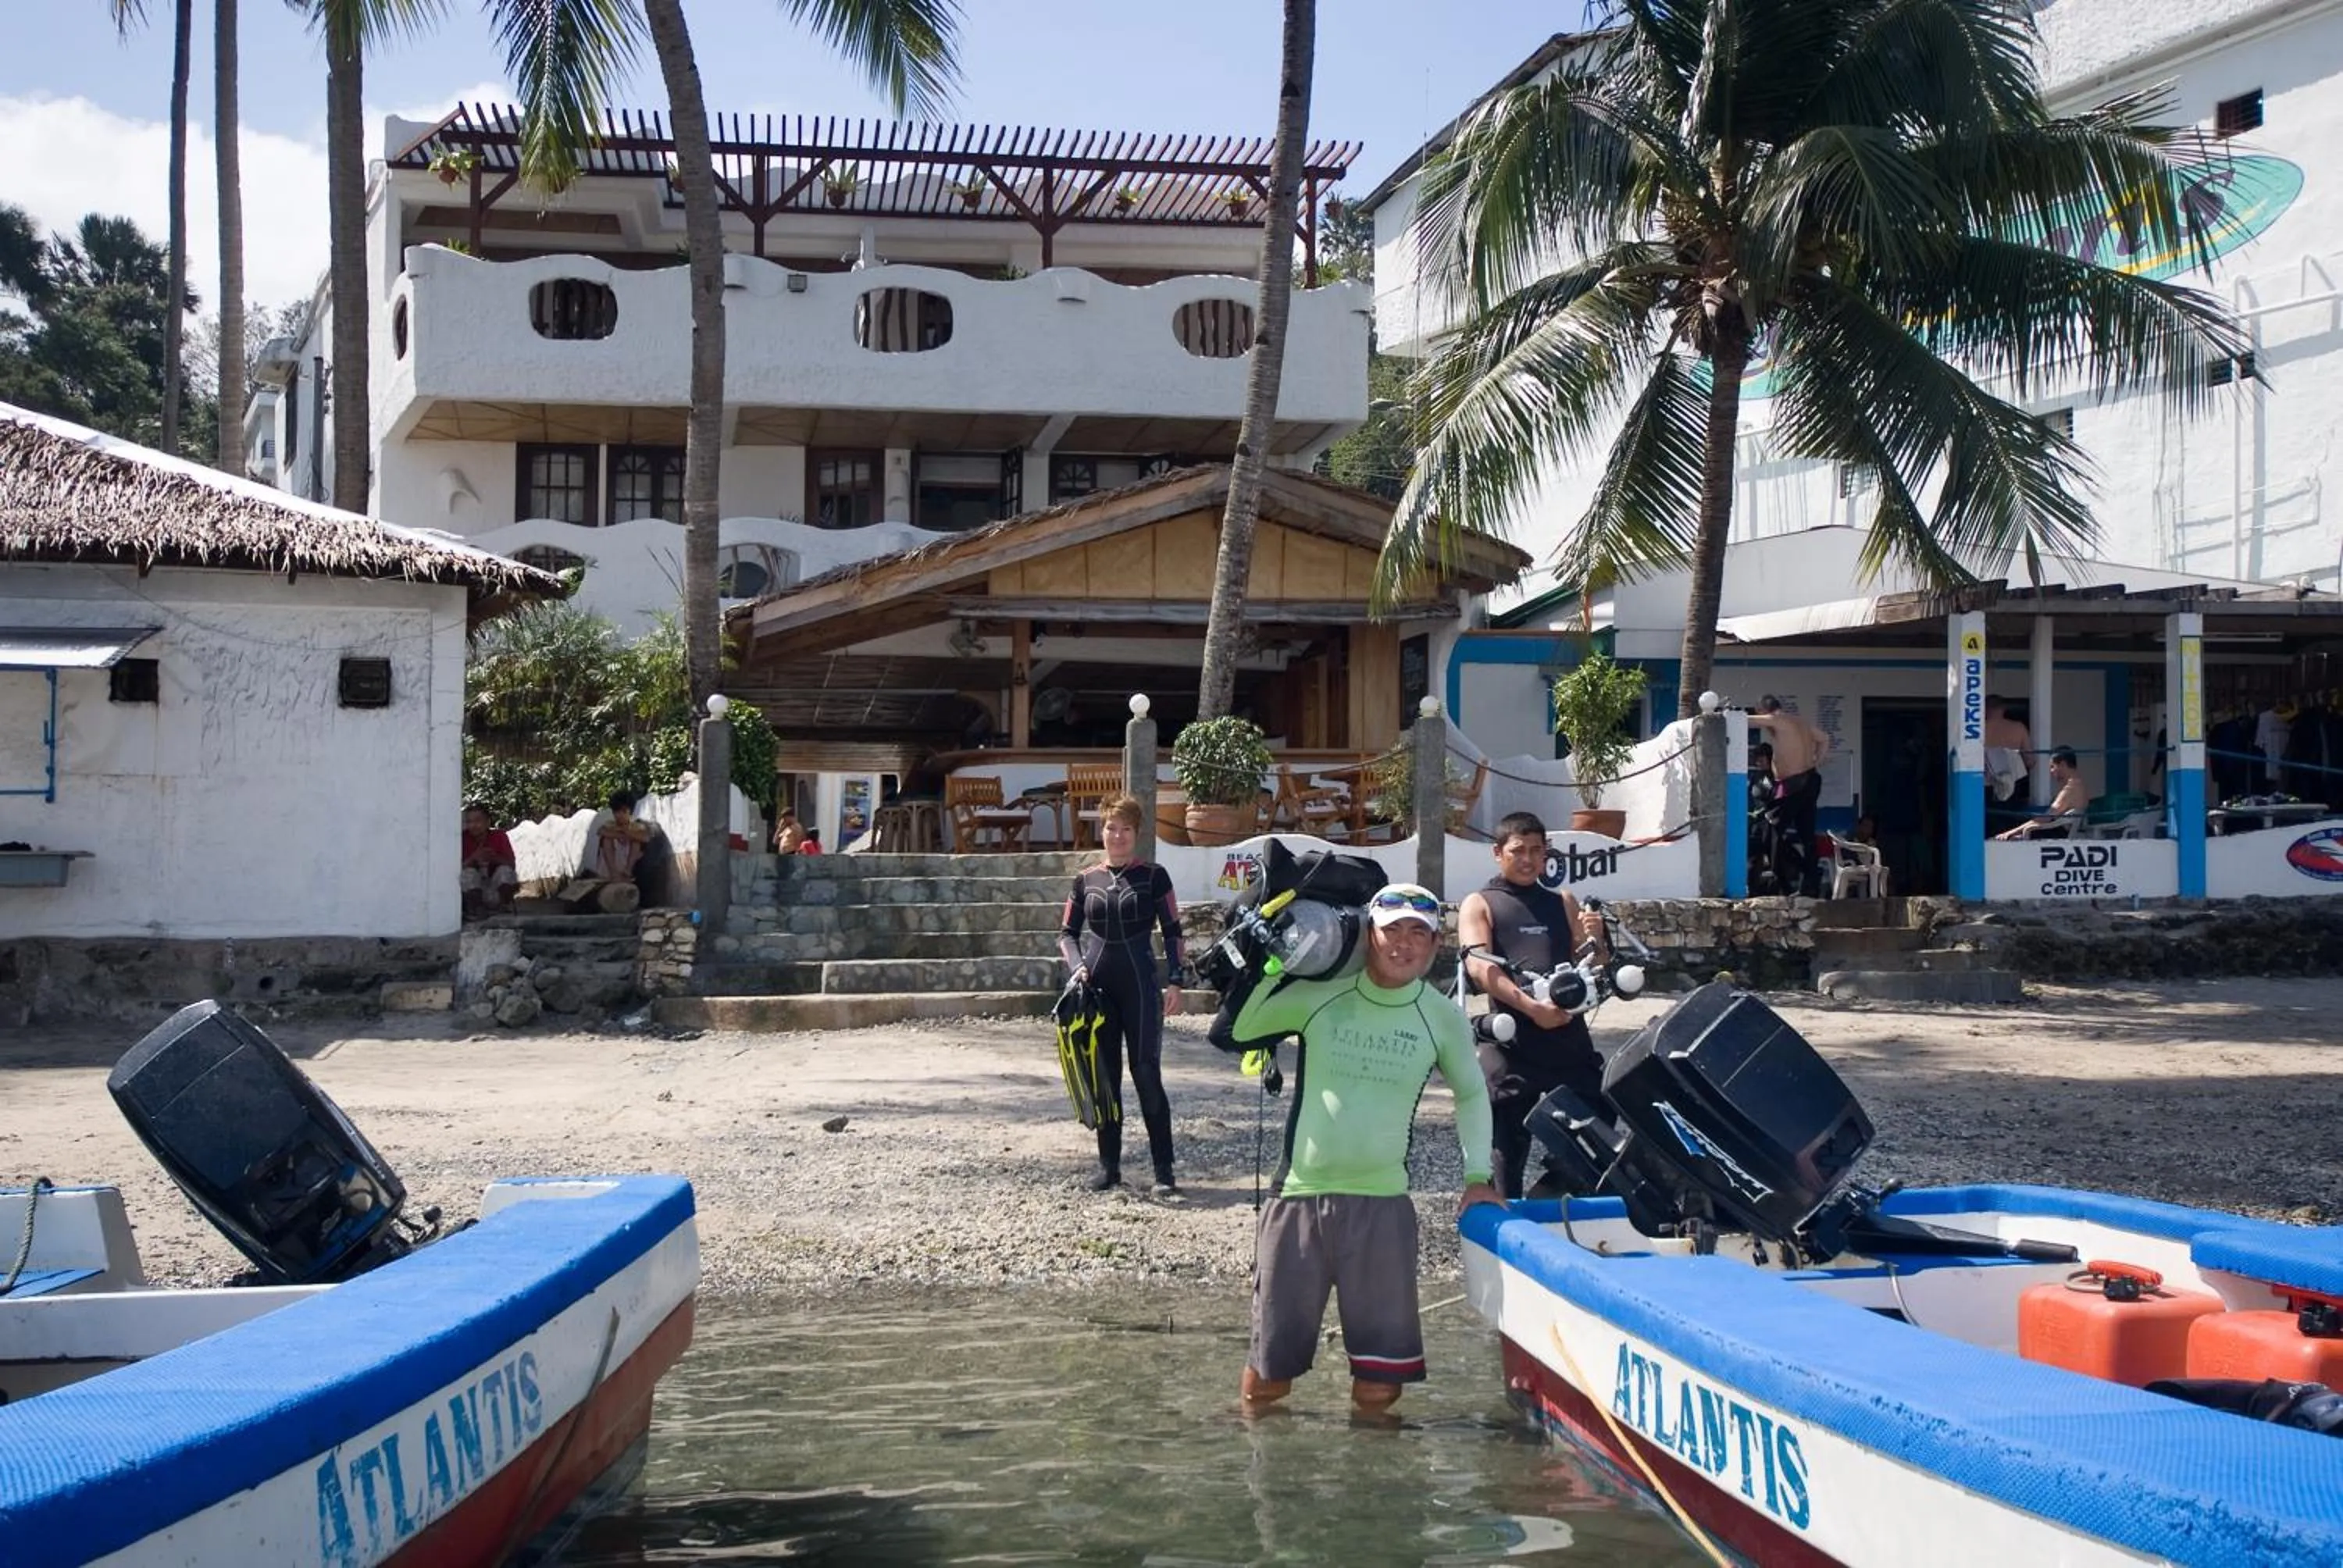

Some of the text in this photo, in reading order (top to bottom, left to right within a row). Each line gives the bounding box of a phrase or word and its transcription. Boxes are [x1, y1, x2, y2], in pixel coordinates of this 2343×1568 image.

[2041, 846, 2117, 868] PADI
[2055, 869, 2105, 882] DIVE
[2041, 882, 2118, 895] Centre
[1614, 1342, 1810, 1531] ATLANTIS
[316, 1350, 543, 1568] ATLANTIS
